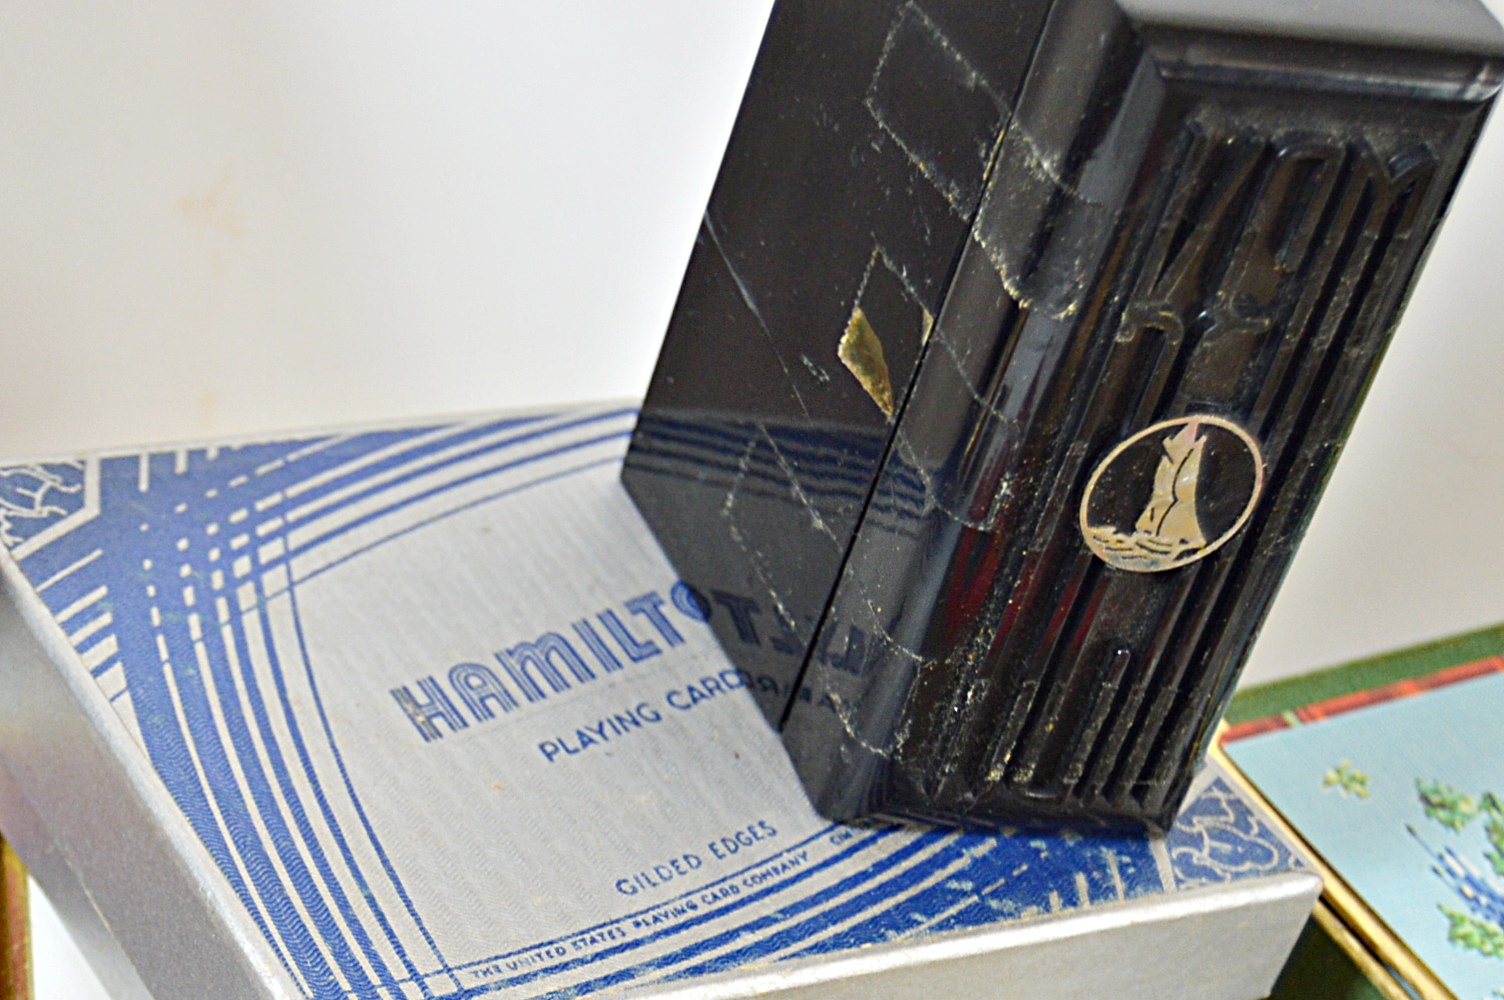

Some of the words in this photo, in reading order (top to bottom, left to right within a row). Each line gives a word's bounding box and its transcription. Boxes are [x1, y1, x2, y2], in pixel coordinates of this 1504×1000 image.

[389, 579, 710, 743] HAMILT
[538, 702, 662, 763] PLAYING
[665, 669, 747, 710] CARD
[615, 853, 703, 896] GILDED
[708, 819, 779, 861] EDGES
[469, 964, 502, 980] THE
[505, 946, 567, 971] UNITED
[570, 926, 627, 952] STATES
[632, 900, 698, 929] PLAYING
[700, 884, 741, 906] CARD
[742, 850, 809, 888] COMPANY
